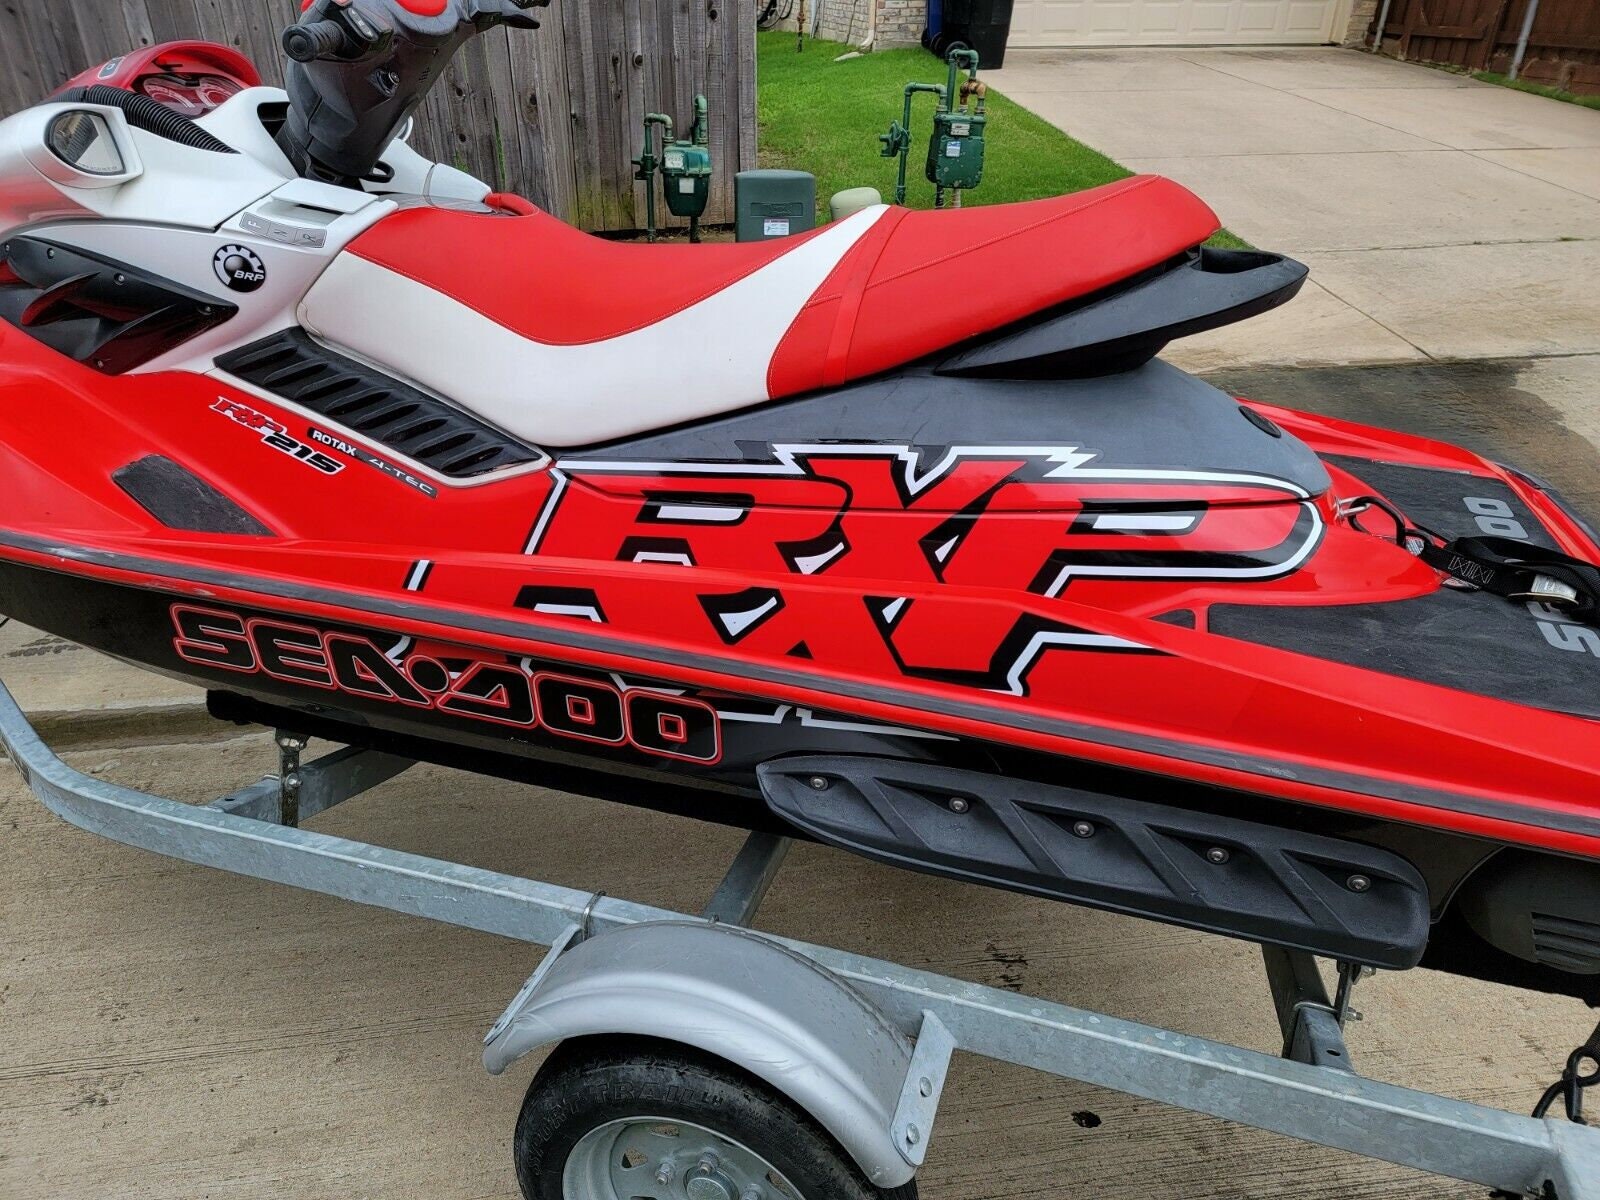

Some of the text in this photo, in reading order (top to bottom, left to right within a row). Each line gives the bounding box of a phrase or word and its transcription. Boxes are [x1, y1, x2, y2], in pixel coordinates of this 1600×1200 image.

[233, 269, 265, 282] BRP
[209, 396, 288, 436] RXP
[261, 431, 346, 475] 215
[312, 429, 435, 494] ROTAX 4-TEC
[405, 443, 1325, 697] RXP
[585, 1081, 701, 1110] TRAIL
